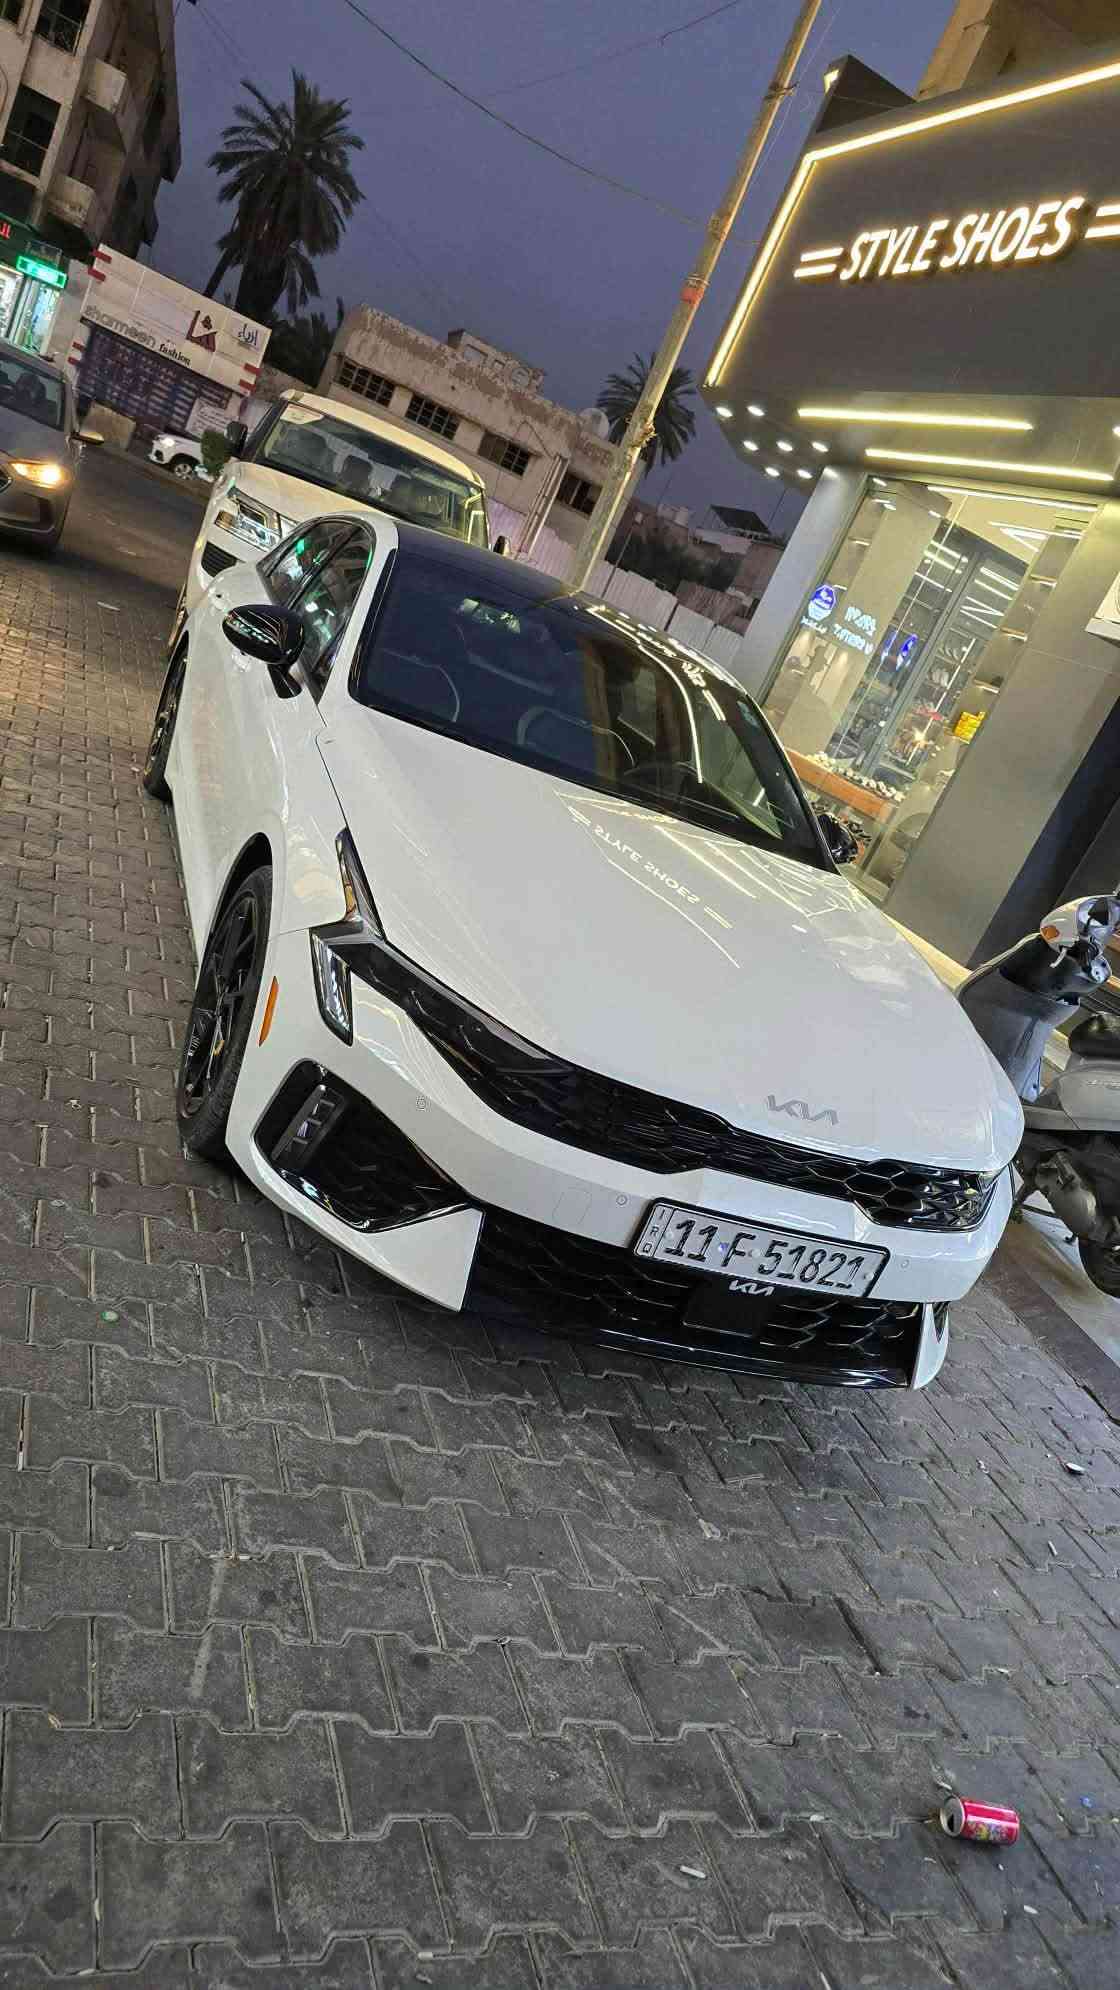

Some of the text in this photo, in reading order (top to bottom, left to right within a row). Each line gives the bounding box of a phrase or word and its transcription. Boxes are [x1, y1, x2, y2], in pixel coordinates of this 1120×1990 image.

[840, 196, 1085, 280] STYLE SHOES
[665, 1219, 865, 1290] 11 F 51821
